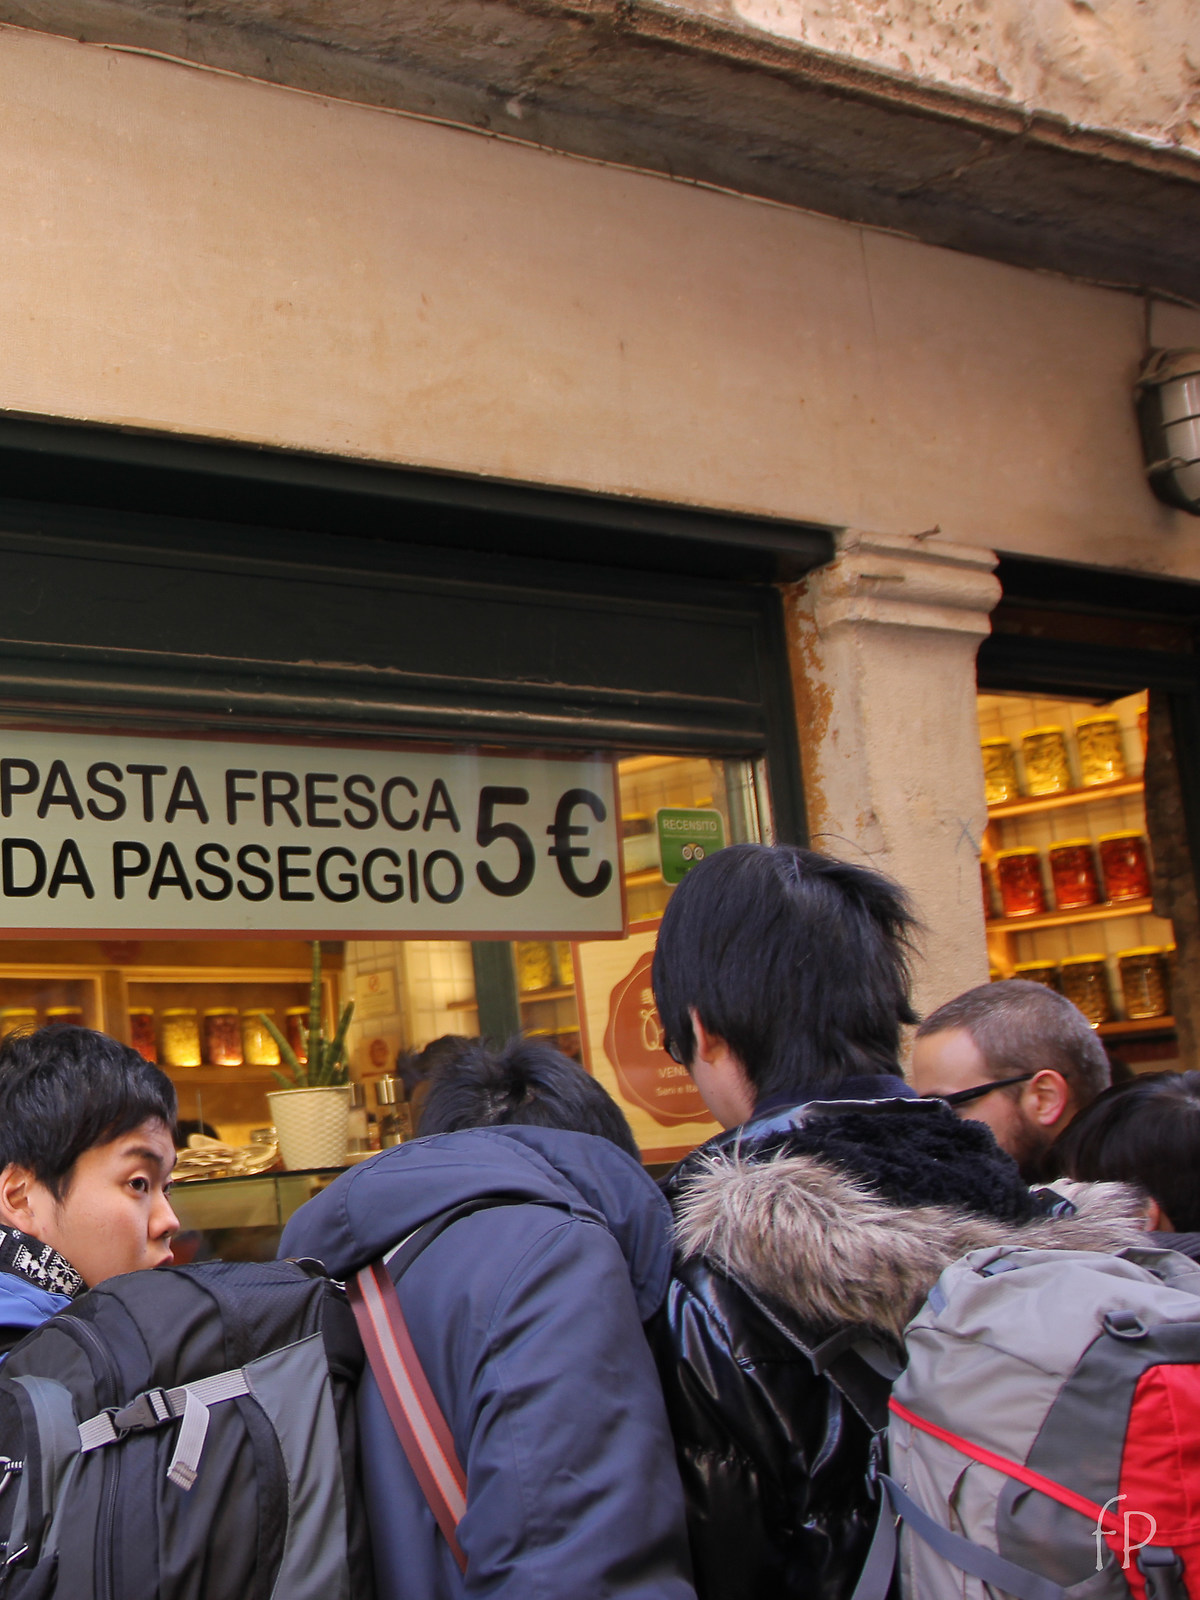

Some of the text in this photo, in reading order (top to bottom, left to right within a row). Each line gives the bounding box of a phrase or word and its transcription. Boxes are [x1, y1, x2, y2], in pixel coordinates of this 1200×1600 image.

[0, 758, 461, 833] PASTA FRESCA
[663, 819, 717, 832] RECENSITO
[2, 838, 464, 904] DA PASSEGGIO
[658, 1066, 690, 1078] VENE
